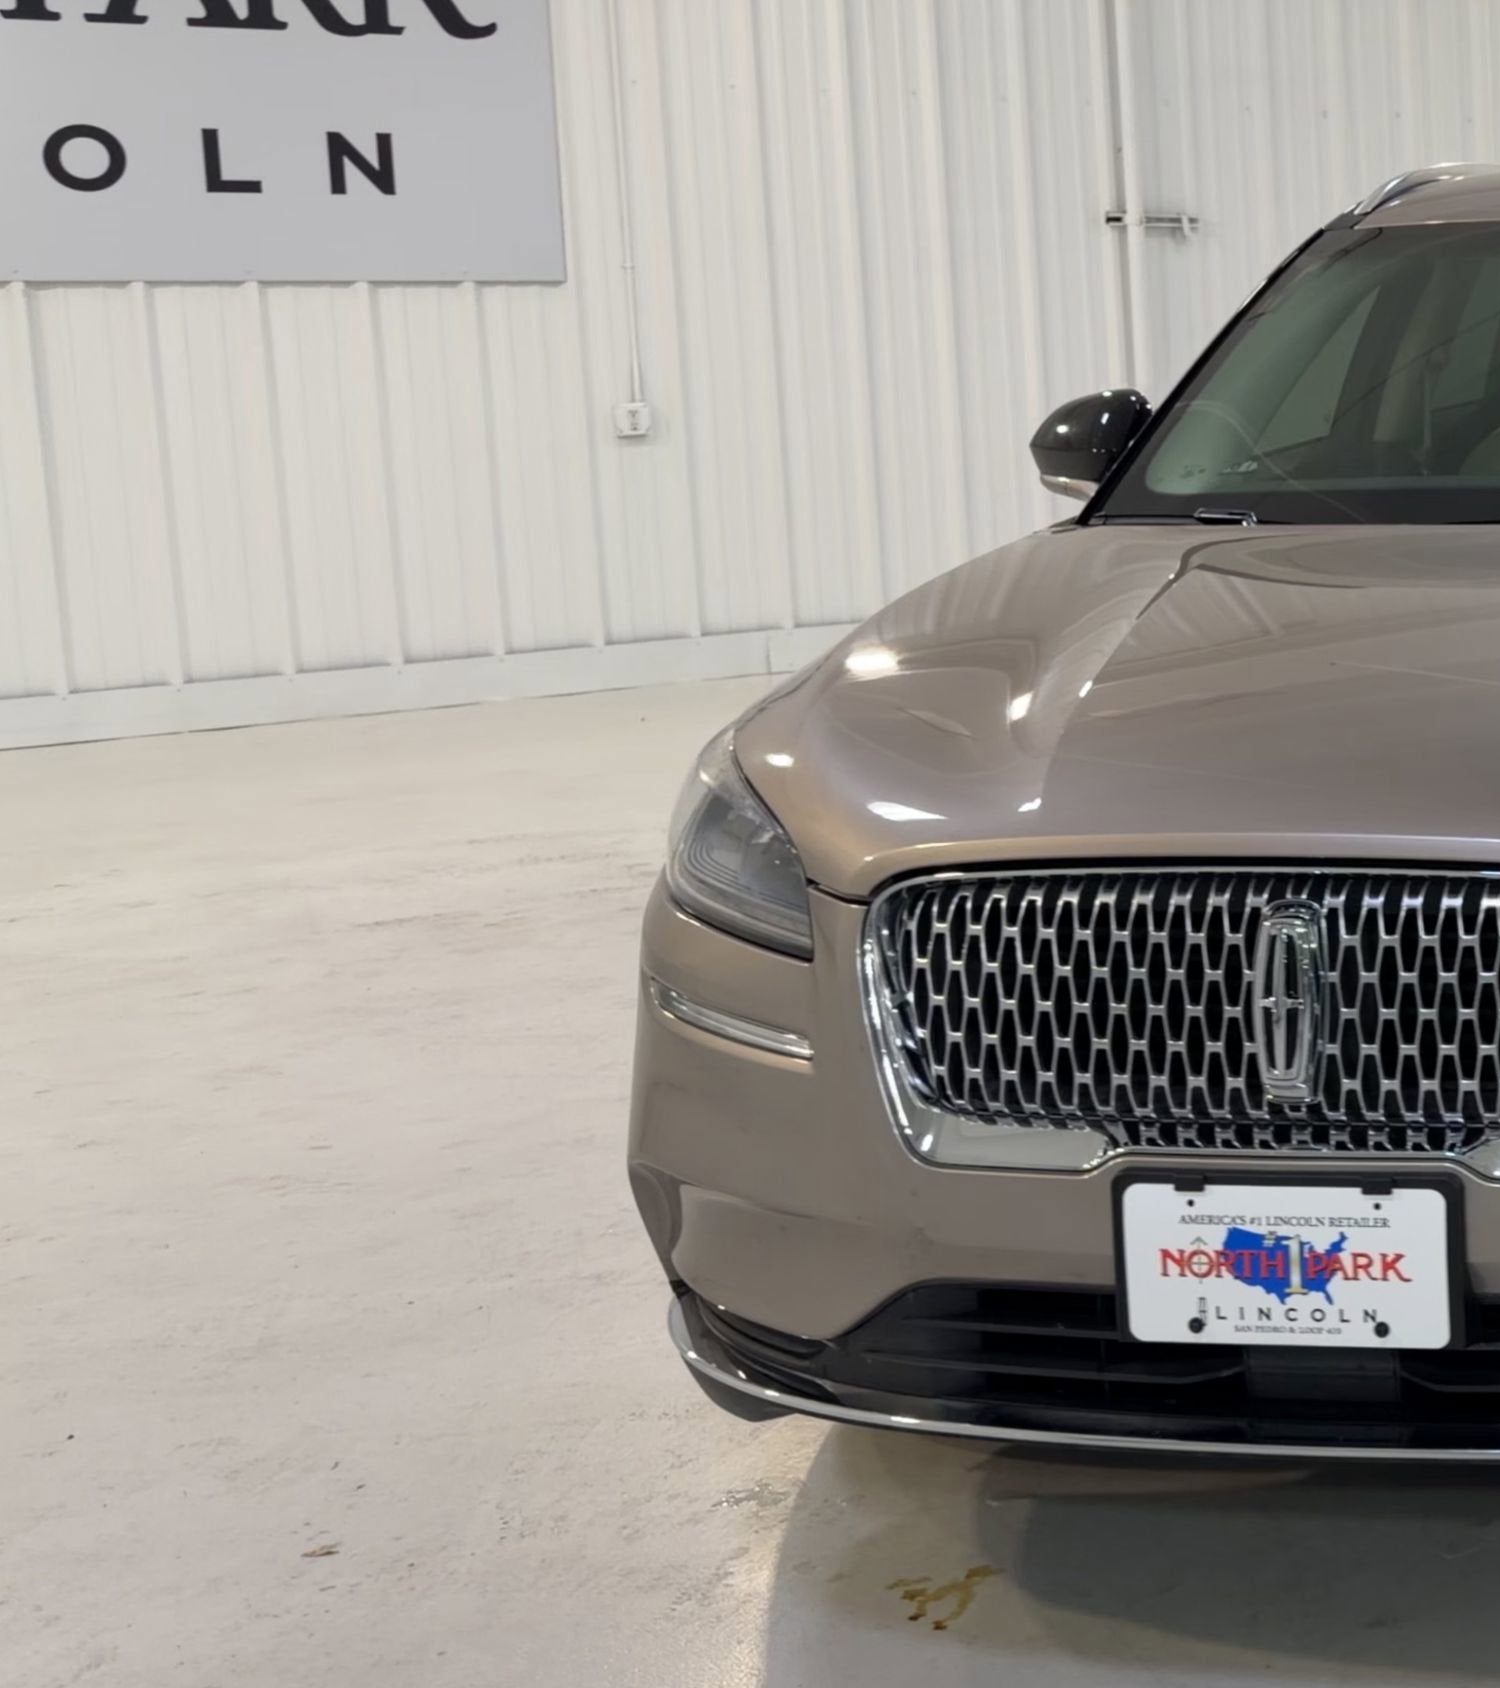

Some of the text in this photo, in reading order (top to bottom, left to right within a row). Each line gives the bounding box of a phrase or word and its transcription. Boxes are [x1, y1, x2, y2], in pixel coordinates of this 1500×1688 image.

[43, 124, 396, 195] OLN
[1178, 1215, 1390, 1228] AMERICA'S #1 LINCOLN RETAILER
[1159, 1249, 1412, 1282] NORTH PARK
[1215, 1306, 1378, 1323] LINCOLN
